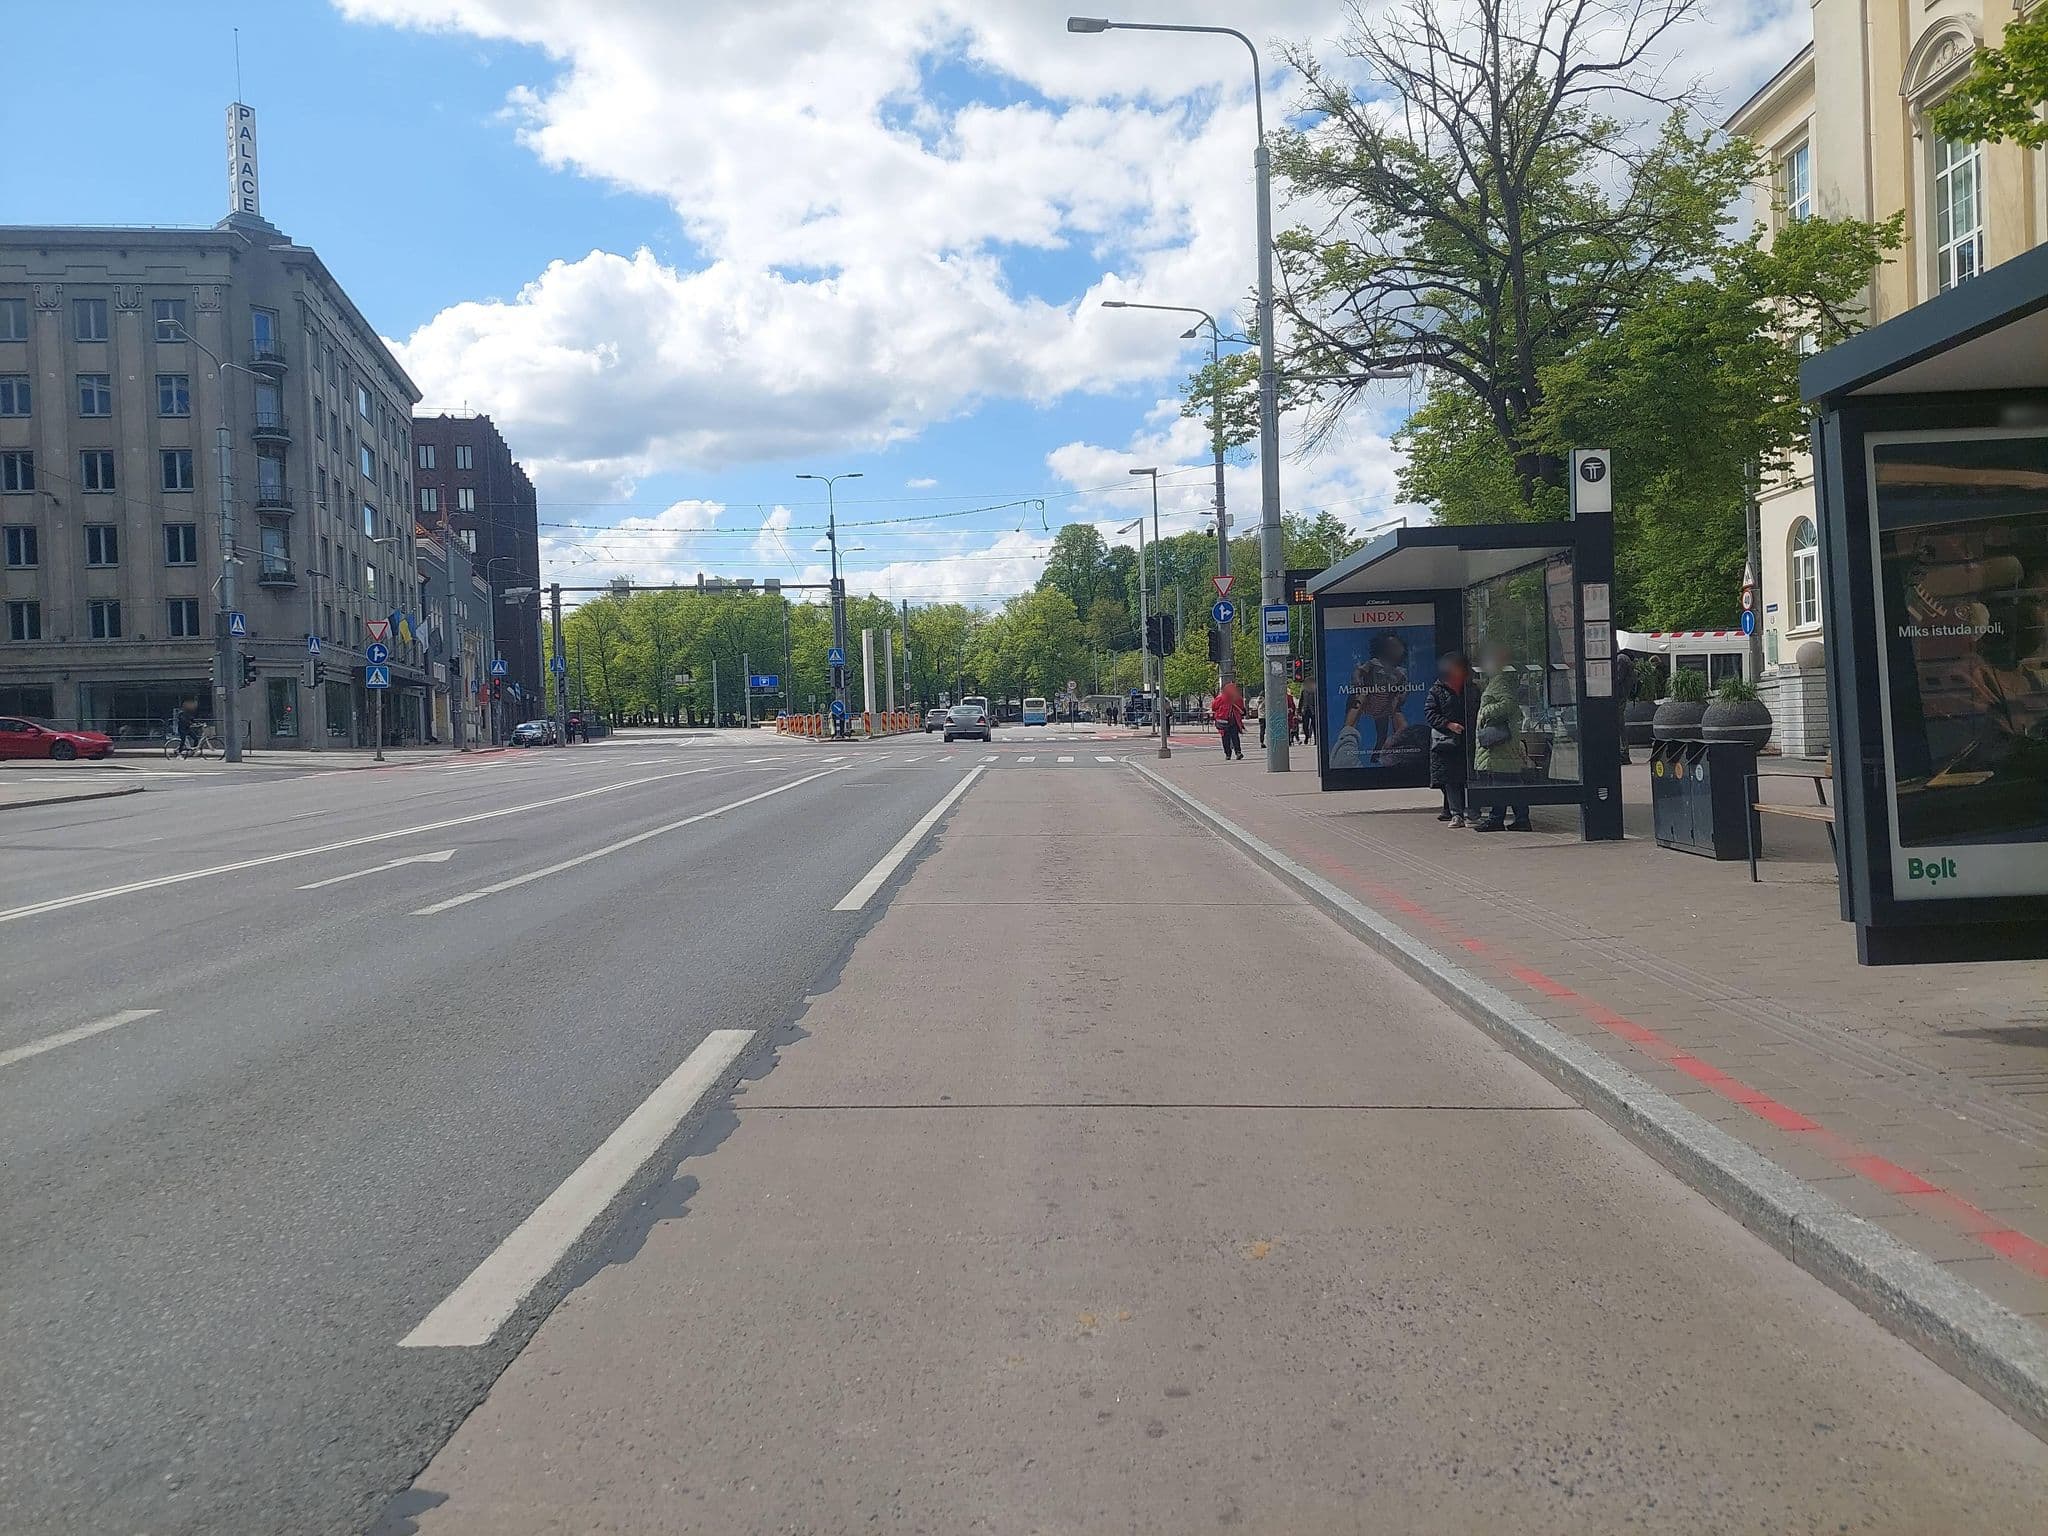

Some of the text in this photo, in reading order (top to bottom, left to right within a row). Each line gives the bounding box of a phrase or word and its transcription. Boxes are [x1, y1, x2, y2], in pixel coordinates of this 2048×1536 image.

[239, 107, 255, 213] PALACE
[1353, 611, 1405, 624] LINDEX
[1899, 625, 1930, 638] Miks
[1932, 624, 1972, 637] istuda
[1388, 682, 1425, 693] loodud
[1908, 856, 1957, 886] Bolt
